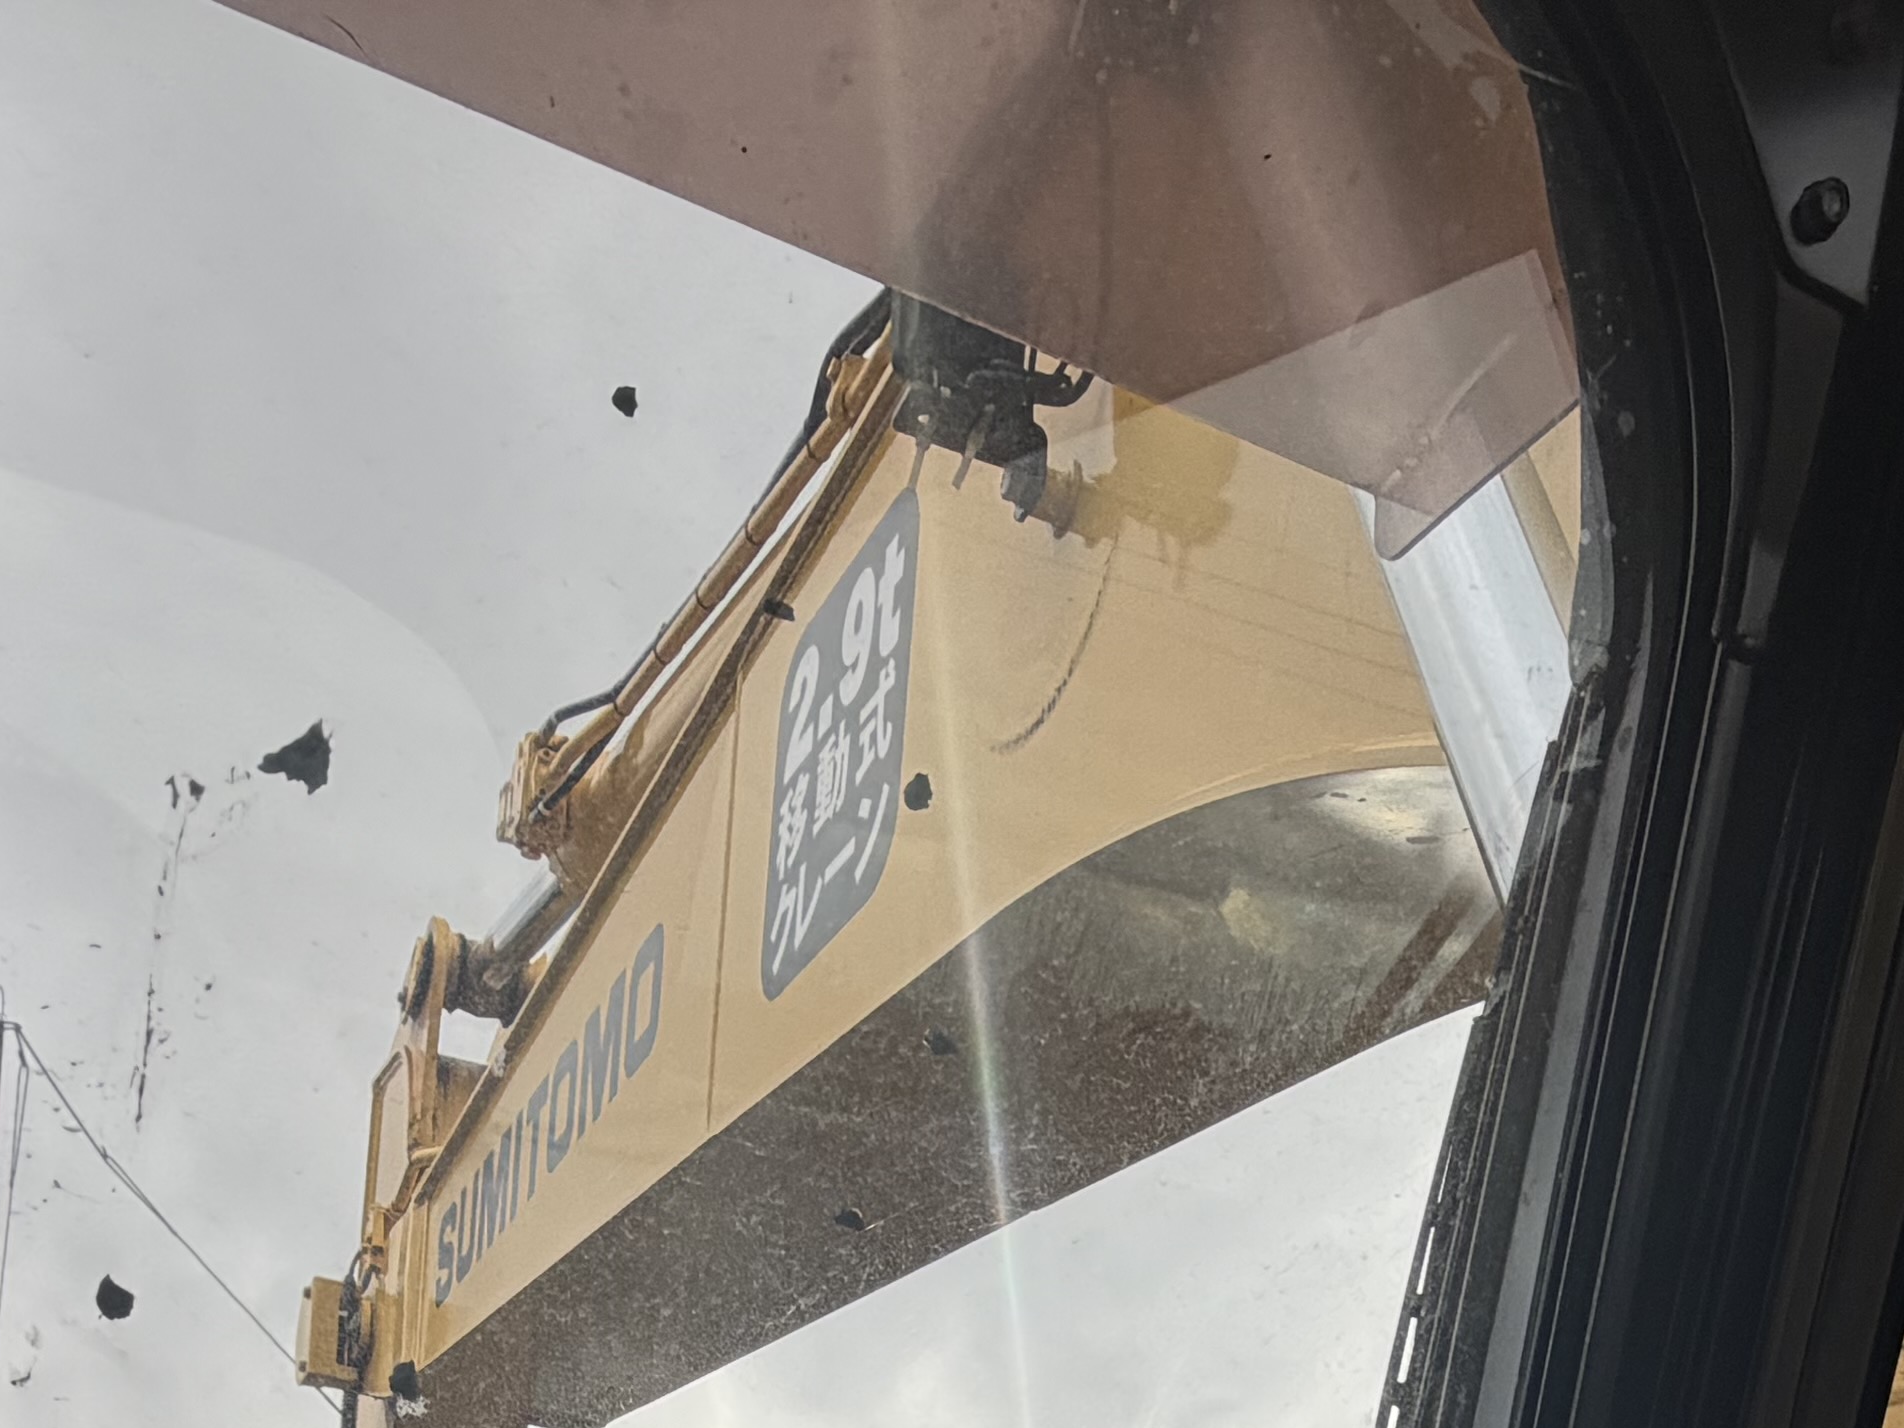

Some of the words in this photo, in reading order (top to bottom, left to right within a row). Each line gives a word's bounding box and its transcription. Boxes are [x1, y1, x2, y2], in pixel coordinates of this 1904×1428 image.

[775, 657, 896, 881] 移動式
[783, 533, 906, 785] 2.9t
[769, 782, 891, 977] クレーン
[435, 922, 665, 1309] SUMITOMO
